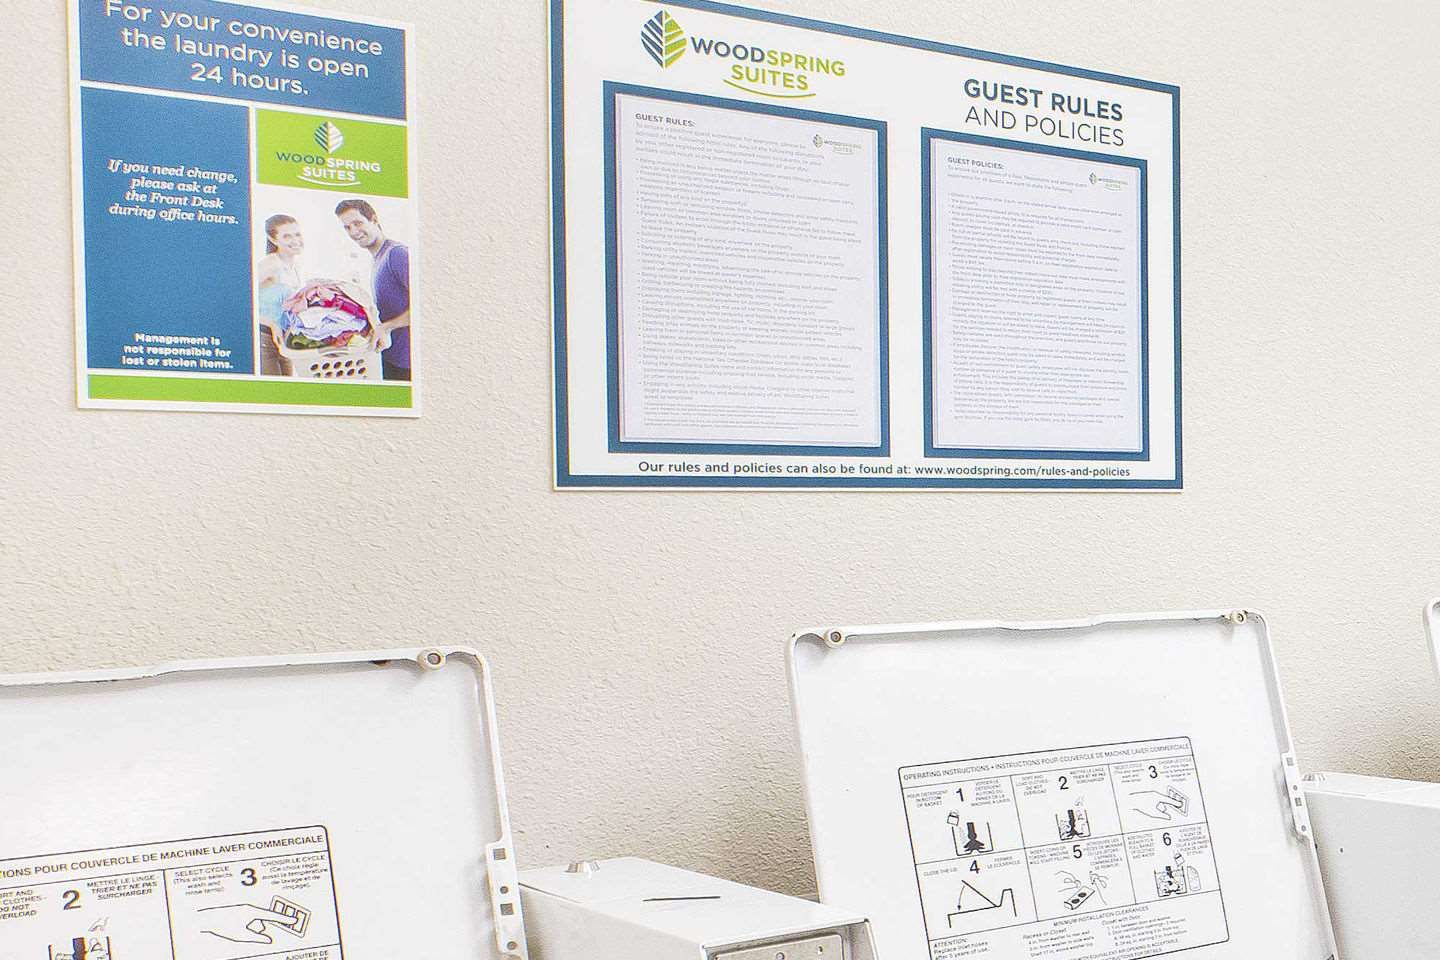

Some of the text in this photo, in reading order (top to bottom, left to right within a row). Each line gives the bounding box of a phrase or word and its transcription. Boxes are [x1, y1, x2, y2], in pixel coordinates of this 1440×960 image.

[105, 0, 382, 56] For your convenience
[121, 26, 368, 81] the laundry is open
[690, 36, 845, 77] WOODSPRING
[191, 62, 308, 95] 24 hours.
[731, 63, 808, 91] SUITES
[964, 77, 1122, 121] GUEST RULES
[635, 113, 694, 127] GUEST RULES:
[965, 104, 1123, 147] AND POLICIES
[107, 158, 237, 184] If you need change,
[276, 151, 381, 173] WOODSPRING
[947, 156, 1003, 169] GUEST POLICIES:
[303, 166, 356, 181] SUITES
[130, 175, 217, 194] please ask at
[125, 189, 223, 209] the Front Desk
[109, 202, 238, 224] during office hours.
[134, 332, 220, 345] Management is
[123, 345, 231, 357] not responsible for
[122, 355, 143, 365] lost
[162, 357, 196, 367] stolen
[199, 359, 232, 369] items.
[639, 461, 1130, 477] Our rules and policies can also be found at: www.woodspring.com/rules-and-policies
[1147, 765, 1158, 778] 3
[1057, 775, 1069, 790] 2
[955, 788, 963, 802] 1
[1161, 831, 1172, 846] 6
[34, 863, 68, 874] POUR
[70, 855, 139, 870] COUVERCLE
[141, 853, 158, 862] DE
[160, 847, 210, 860] MACHINE
[212, 843, 247, 853] LAVER
[248, 834, 323, 849] COMMERCIALE
[1072, 845, 1083, 858] 5
[968, 859, 980, 874] 4
[239, 867, 257, 887] 3
[61, 888, 82, 910] 2
